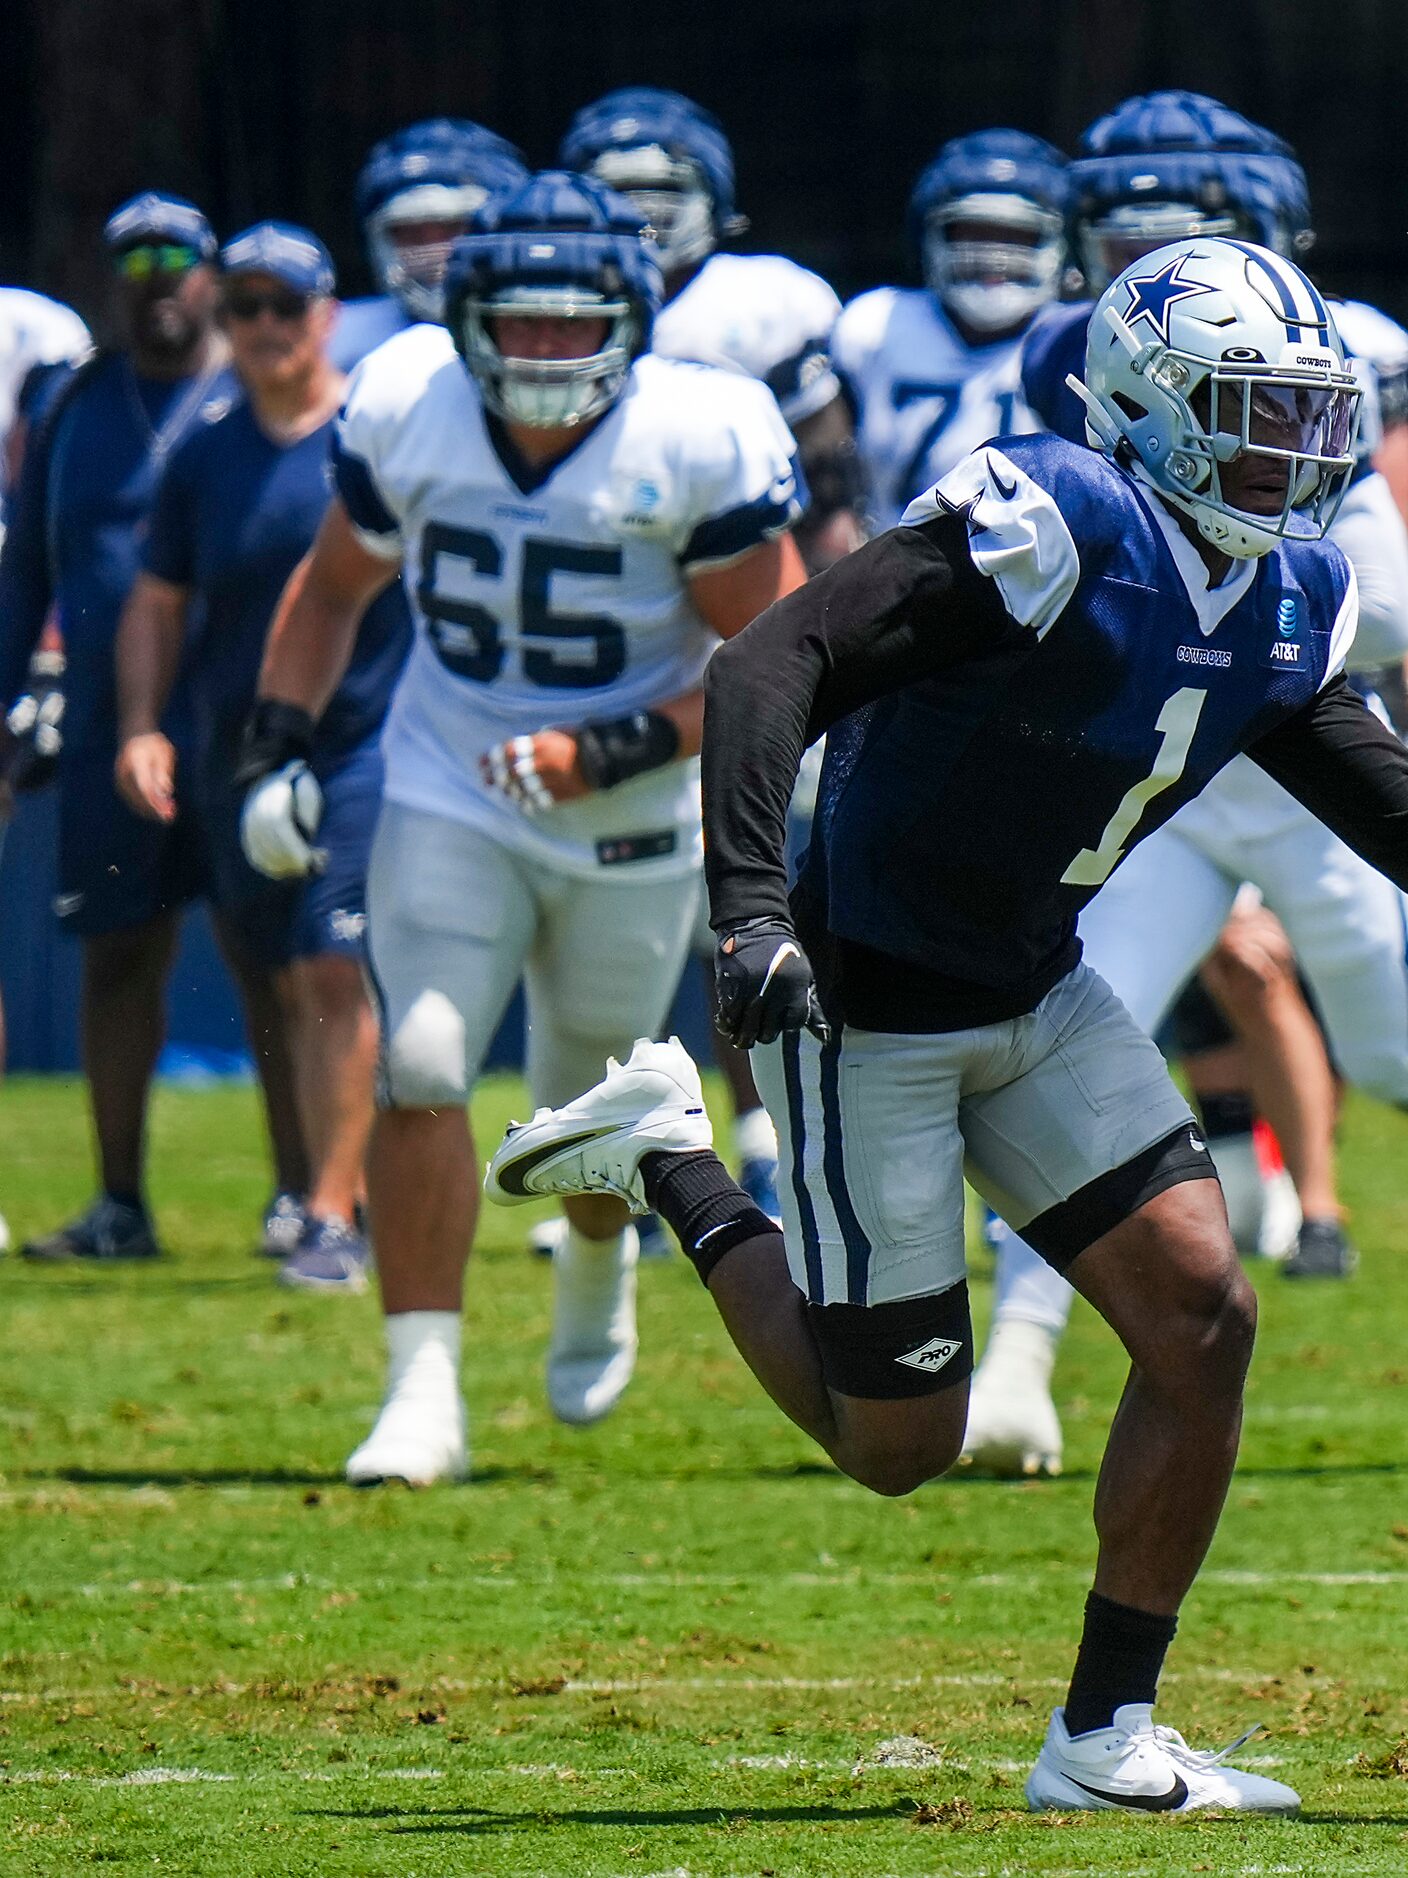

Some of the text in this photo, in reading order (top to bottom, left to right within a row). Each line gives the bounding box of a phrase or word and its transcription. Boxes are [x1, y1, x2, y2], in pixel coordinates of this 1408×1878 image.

[1296, 356, 1332, 368] COWBOYS
[418, 521, 627, 688] 65
[1177, 645, 1232, 667] COWBOYS
[1270, 642, 1300, 662] AT&T
[1060, 686, 1208, 885] 1
[917, 1345, 951, 1364] PRO
